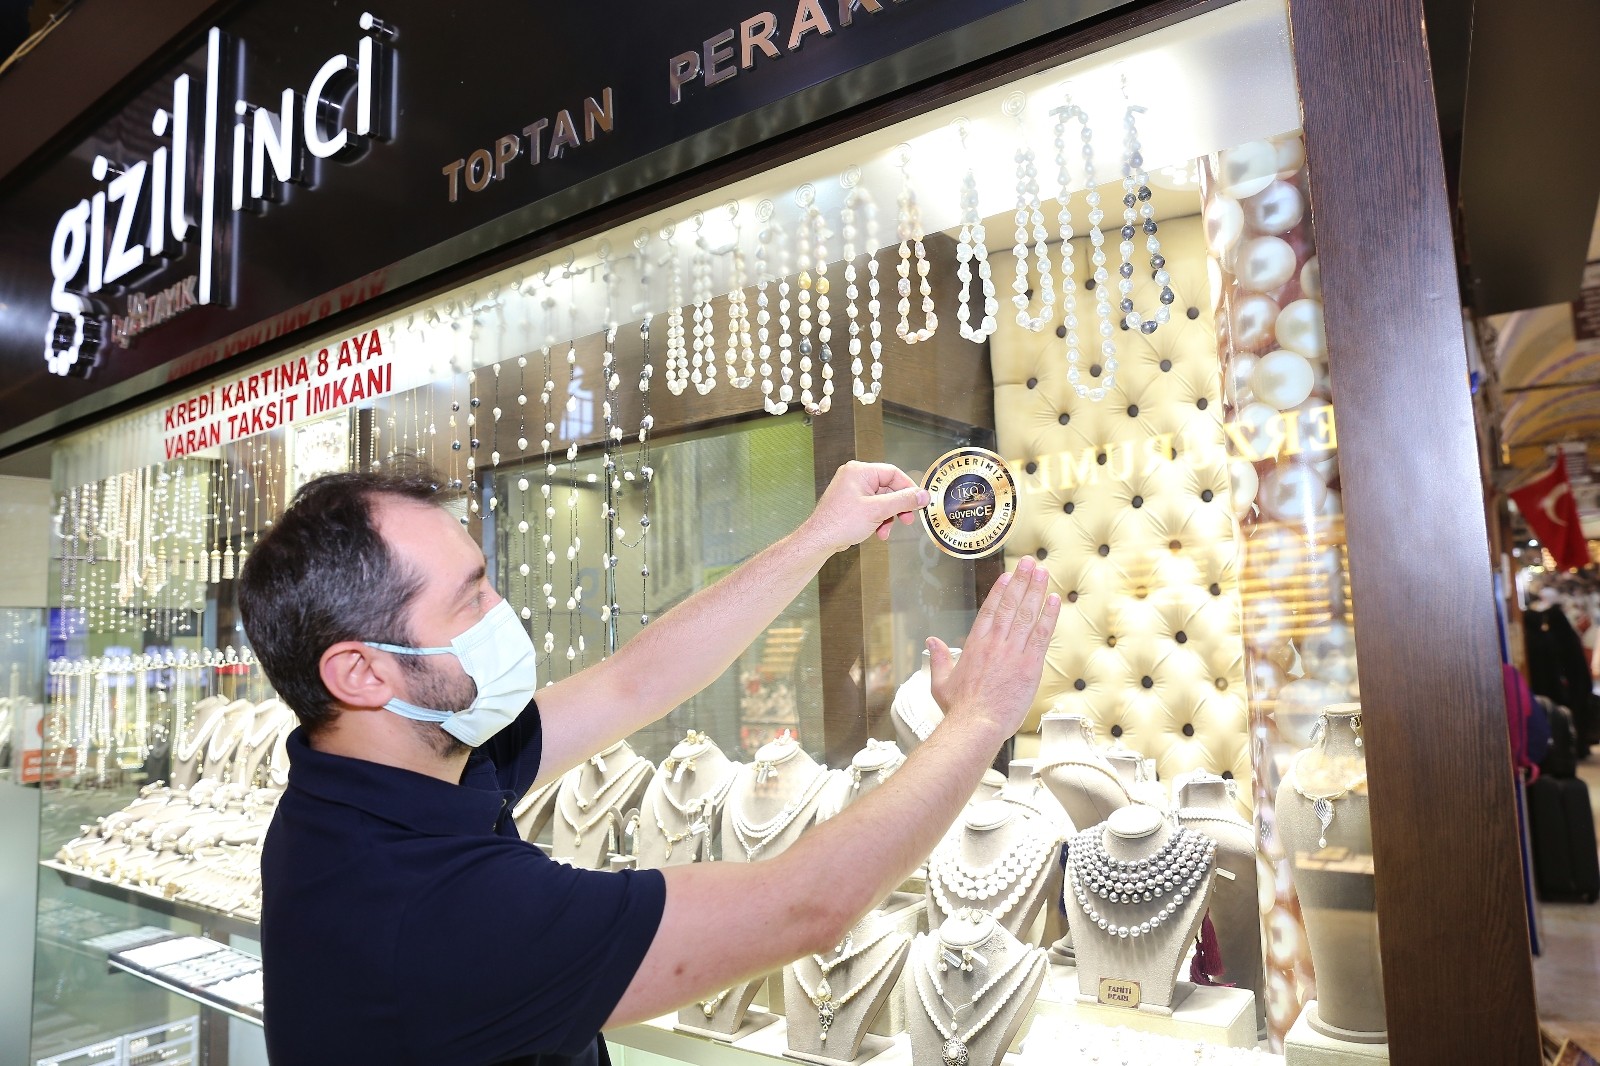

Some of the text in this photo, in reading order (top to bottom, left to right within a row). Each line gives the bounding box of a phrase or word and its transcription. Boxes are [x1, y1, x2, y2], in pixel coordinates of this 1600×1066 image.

[442, 0, 906, 203] TOPTAN PERA
[164, 385, 215, 431] KREDİ
[221, 357, 309, 411] KARTINA
[317, 348, 329, 377] 8
[336, 329, 383, 370] AYA
[164, 362, 392, 461] VARAN TAKSİT İMKANI
[930, 457, 1004, 493] ÜRÜNLERİMİZ
[939, 529, 973, 548] GÜVENCE
[975, 502, 1011, 547] ETİKETLİDİR
[949, 504, 993, 520] GÜVENCE
